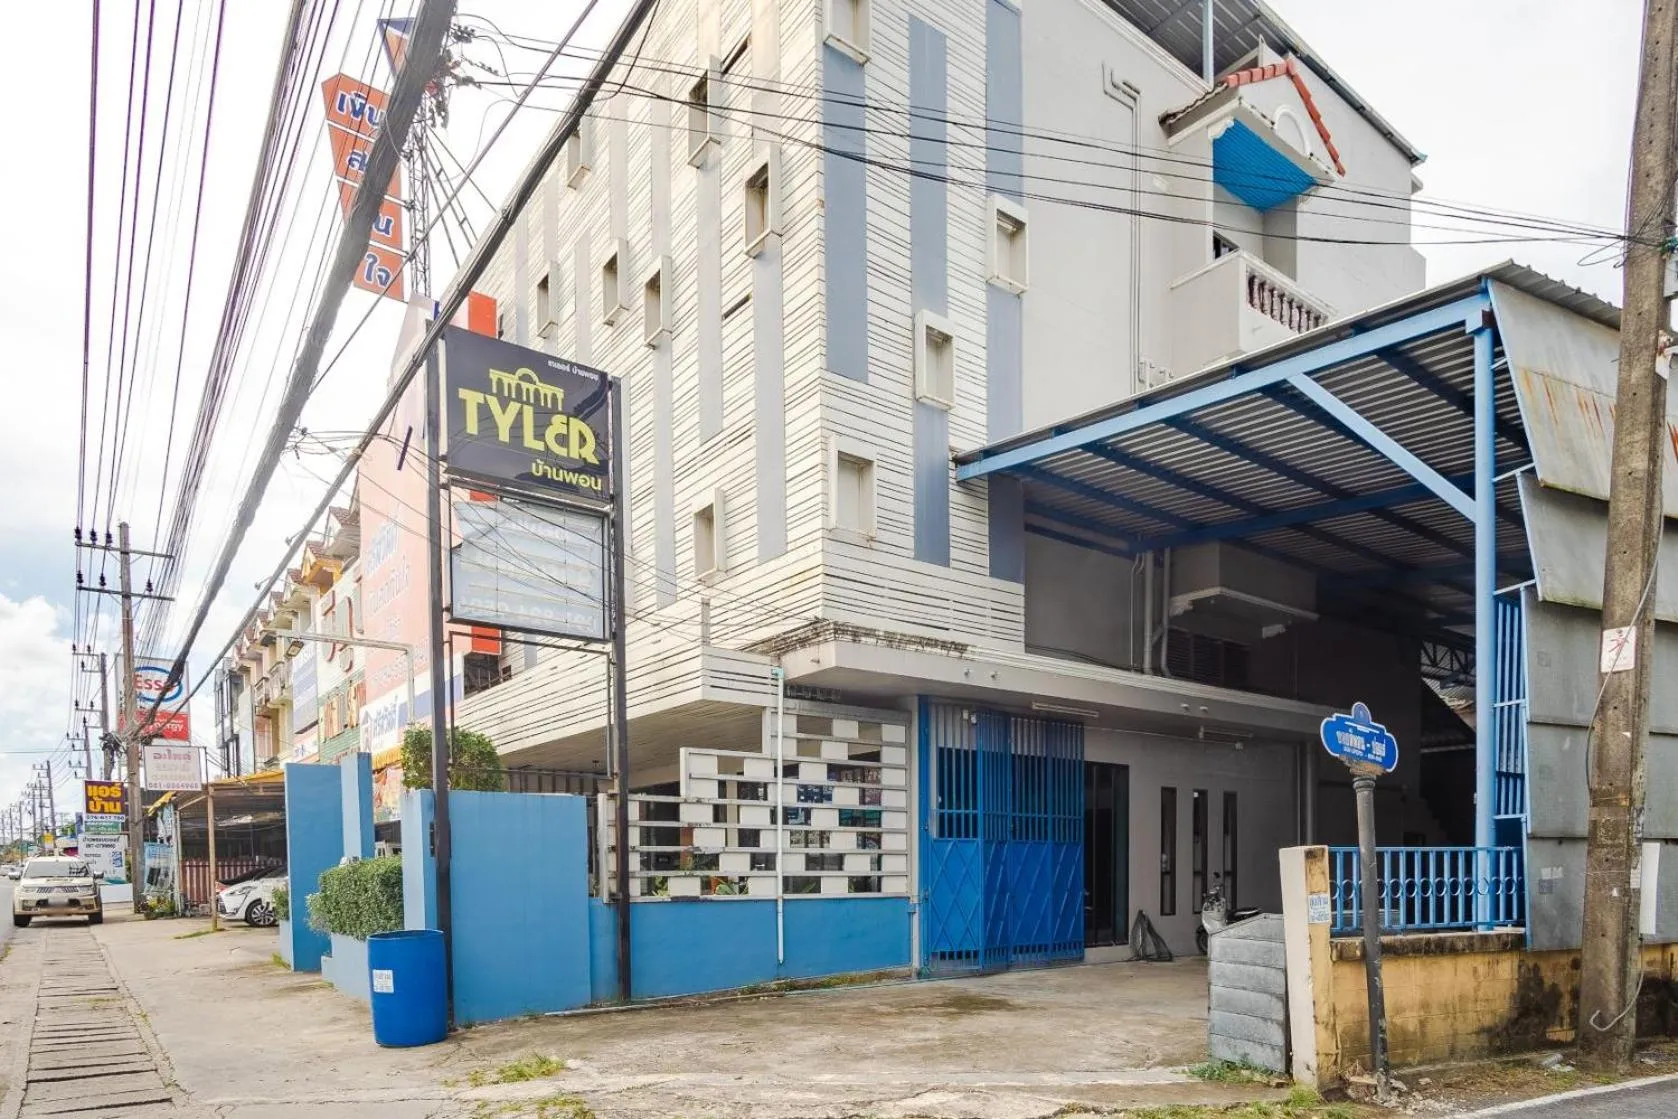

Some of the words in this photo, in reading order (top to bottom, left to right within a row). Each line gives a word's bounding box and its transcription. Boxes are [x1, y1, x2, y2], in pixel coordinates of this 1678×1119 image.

[458, 387, 599, 465] TYLER
[532, 459, 602, 492] บ้านพอน
[87, 783, 122, 798] แอร์
[89, 796, 122, 813] บ้าน
